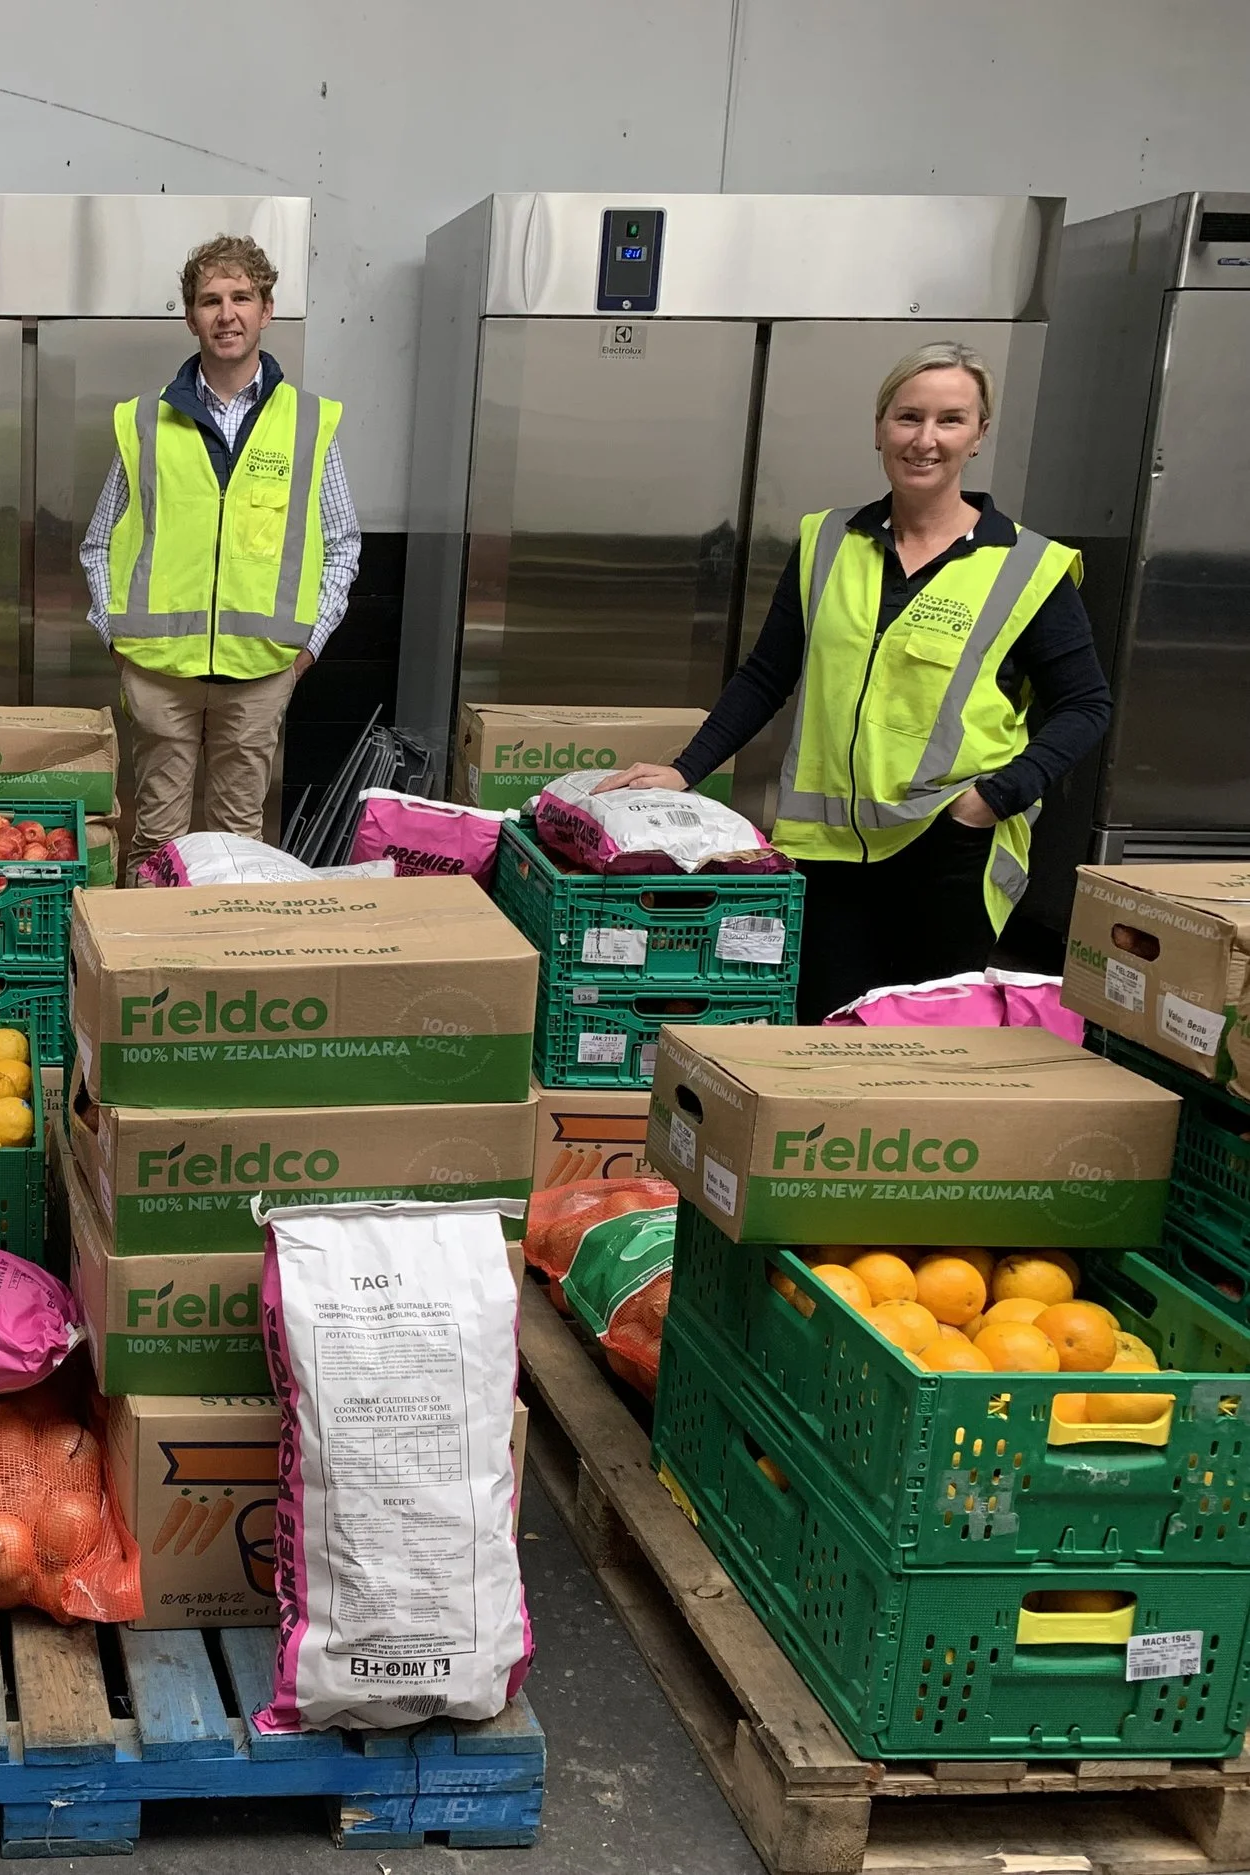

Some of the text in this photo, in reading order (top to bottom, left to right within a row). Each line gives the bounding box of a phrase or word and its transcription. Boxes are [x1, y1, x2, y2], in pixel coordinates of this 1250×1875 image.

[601, 346, 642, 355] Electrolux
[493, 738, 617, 770] Fieldco
[0, 774, 49, 785] KUMARA
[493, 774, 549, 786] 100% NEW
[381, 844, 466, 875] PREMIER
[297, 896, 339, 906] STORE
[308, 901, 378, 915] DO NOT
[1093, 886, 1173, 925] ZEALAND GROWN
[223, 945, 403, 959] HANDLE WITH CARE
[120, 986, 329, 1036] Fieldco
[421, 1016, 474, 1041] 100%
[121, 1040, 410, 1064] 100% NEW ZEALAND KUMARA
[416, 1035, 467, 1058] LOCAL
[932, 1079, 983, 1088] WITH
[771, 1122, 979, 1173] Fieldco
[137, 1141, 340, 1188] Fieldco
[769, 1181, 1054, 1200] 100% NEW ZEALAND KUMARA
[1060, 1179, 1108, 1202] LOCAL
[138, 1197, 184, 1213] 100%
[188, 1195, 231, 1212] NEW
[237, 1191, 332, 1209] ZALAND
[350, 1273, 403, 1291] TAG 1
[126, 1280, 258, 1328] Field
[314, 1302, 433, 1314] THESE POTATOES ARE SUITABLE
[325, 1329, 449, 1341] POTATOES NUTRITIONAL VALUE
[126, 1338, 173, 1354] 100%
[177, 1338, 221, 1354] NEW
[343, 1395, 442, 1406] GENERAL GUIDELINES OF
[333, 1403, 452, 1415] COOKING QUALITIES OF SOME
[335, 1413, 452, 1423] COMMON POTATO VARIETIES
[383, 1498, 416, 1507] RECIPES
[186, 1605, 271, 1618] Produce of
[403, 1662, 427, 1676] DAY
[404, 1677, 446, 1686] vegetables
